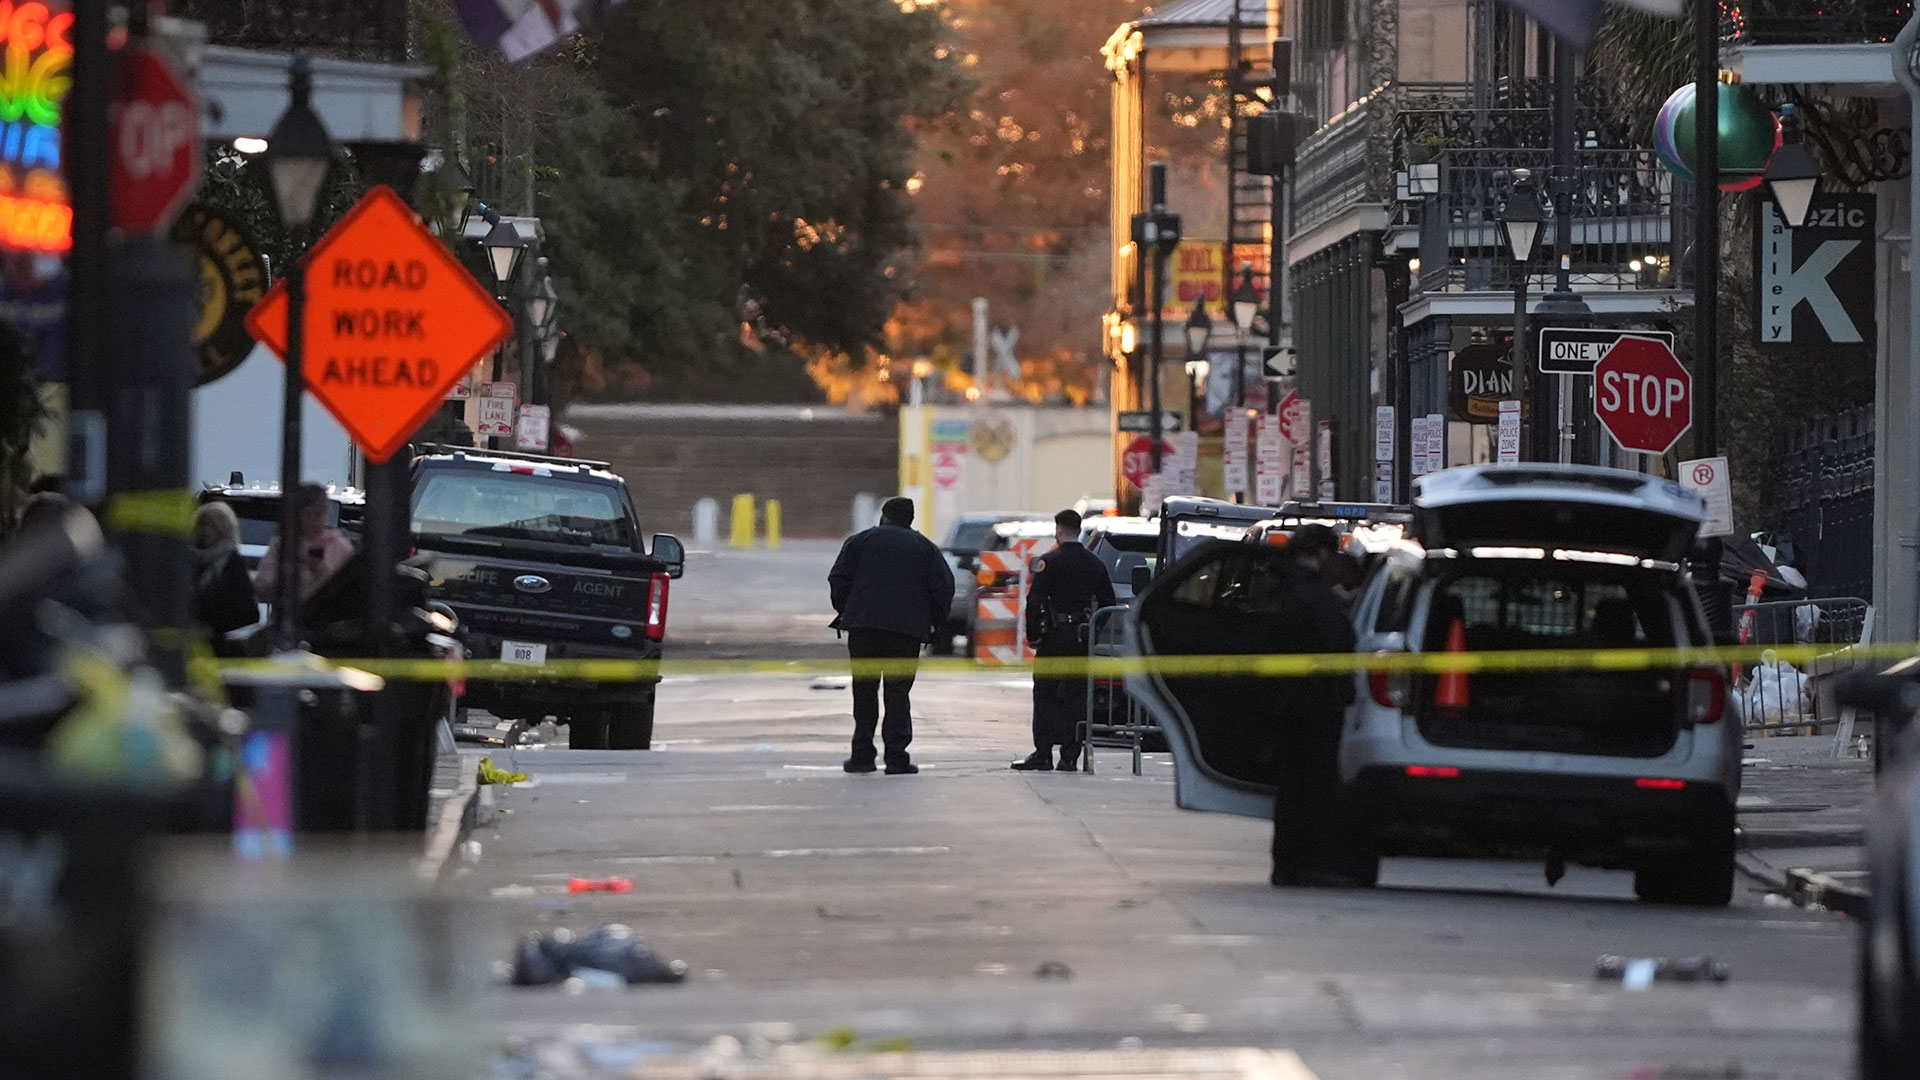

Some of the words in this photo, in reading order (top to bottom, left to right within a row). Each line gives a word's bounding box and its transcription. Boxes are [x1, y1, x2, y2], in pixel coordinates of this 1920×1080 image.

[120, 102, 189, 180] OP
[334, 259, 428, 291] ROAD
[1762, 201, 1864, 342] K
[332, 309, 426, 338] WORK
[1555, 343, 1589, 359] ONE
[322, 357, 439, 387] AHEAD
[1463, 369, 1514, 395] DIAN
[1601, 370, 1685, 418] STOP
[487, 400, 504, 409] FIRE
[485, 411, 506, 420] LANE
[1427, 428, 1442, 438] POLICE
[1500, 427, 1518, 438] POLICE
[1429, 440, 1441, 449] ZONE
[1501, 439, 1516, 450] ZONE
[1125, 451, 1149, 474] ST
[1336, 507, 1366, 516] NOPD
[573, 581, 624, 598] AGENT
